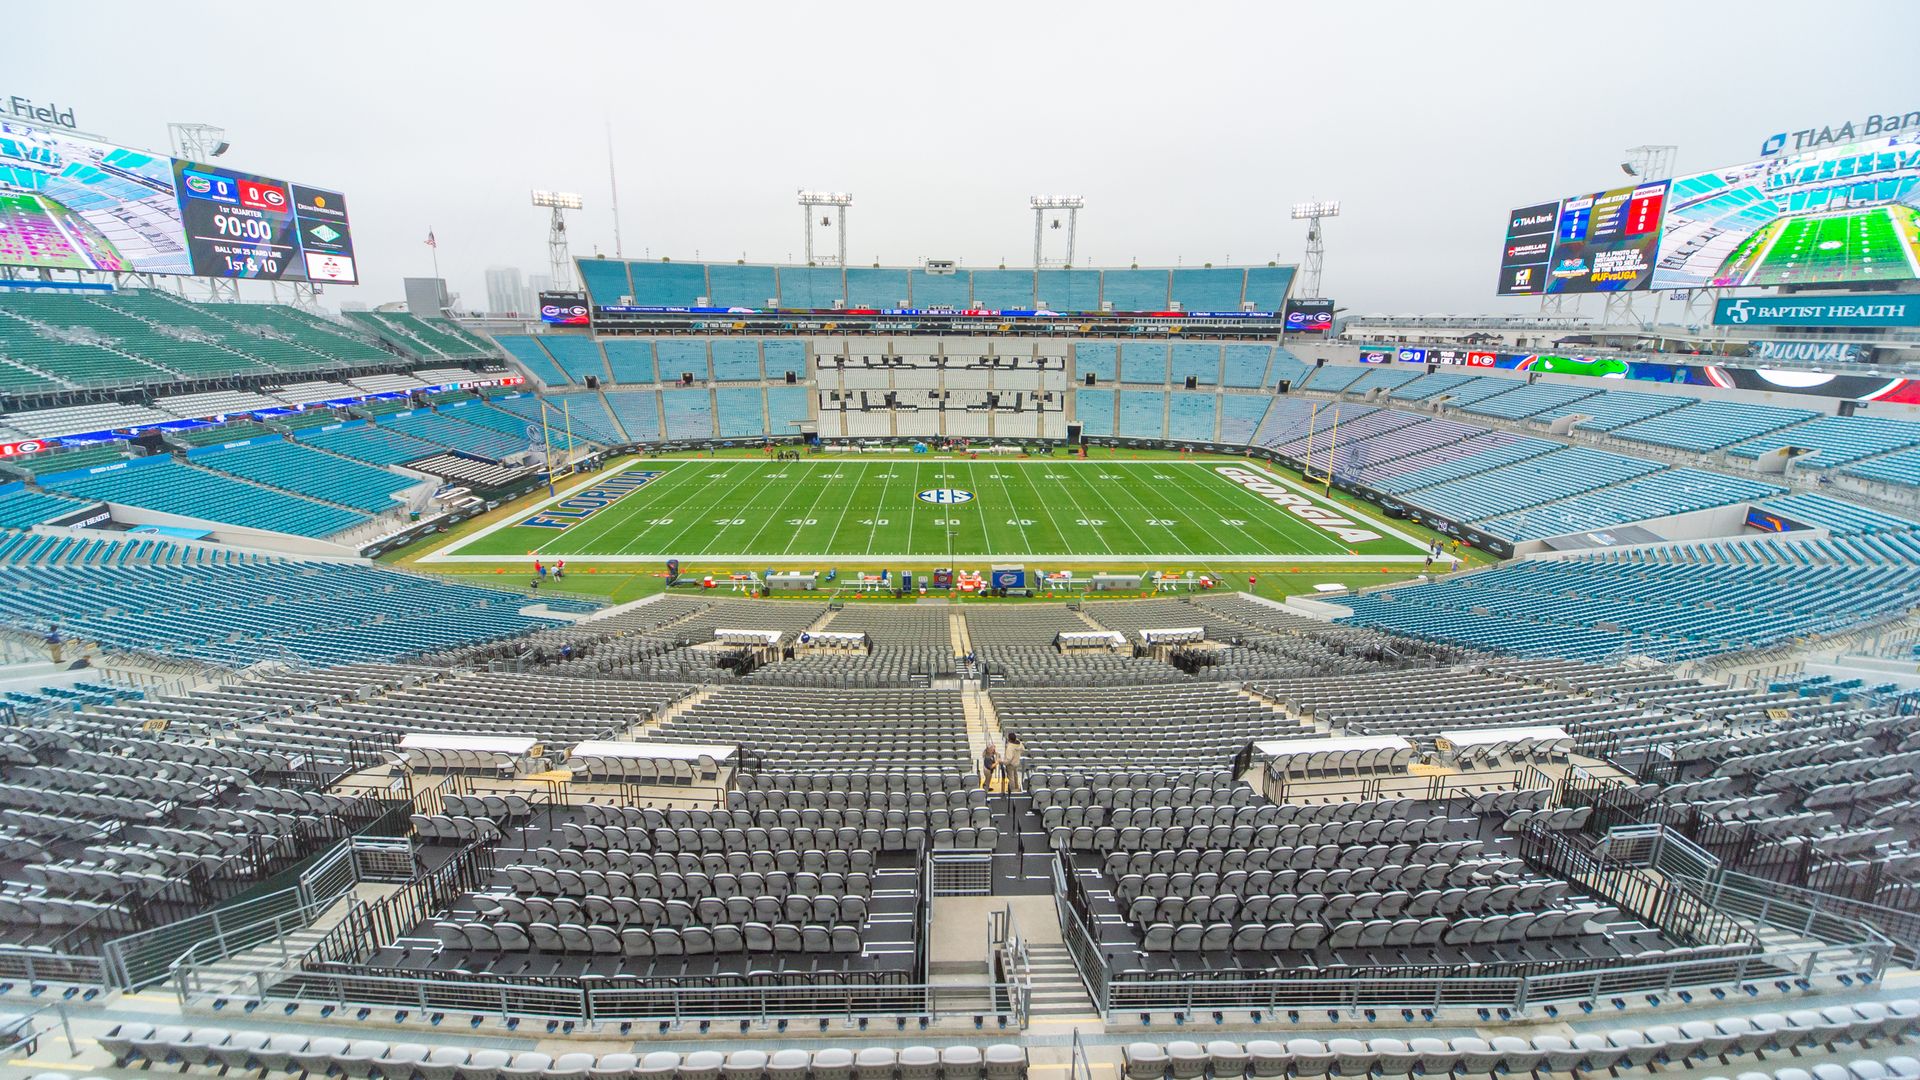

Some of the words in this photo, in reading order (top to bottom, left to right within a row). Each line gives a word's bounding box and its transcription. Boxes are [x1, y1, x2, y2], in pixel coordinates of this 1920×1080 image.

[11, 96, 76, 128] Field
[1792, 120, 1856, 150] TIAA
[217, 182, 228, 195] 0
[248, 188, 259, 200] 0
[231, 207, 262, 218] QUARTER
[1521, 216, 1535, 226] TIAA
[1536, 213, 1553, 223] Bank
[214, 214, 272, 240] 90:00
[214, 246, 232, 254] BALL
[251, 249, 268, 257] YARD
[225, 256, 244, 270] 1ST
[246, 257, 258, 272] &
[261, 259, 278, 273] 10
[1591, 271, 1636, 282] #UFvsUGA
[1759, 306, 1825, 318] BAPTIST
[1827, 305, 1905, 317] HEALTH
[1414, 352, 1420, 360] 0
[1472, 355, 1479, 364] 0
[106, 462, 128, 471] LIGHT
[512, 470, 666, 530] FLORIDA
[1214, 467, 1383, 543] GEORGIA
[86, 512, 110, 525] HEALTH
